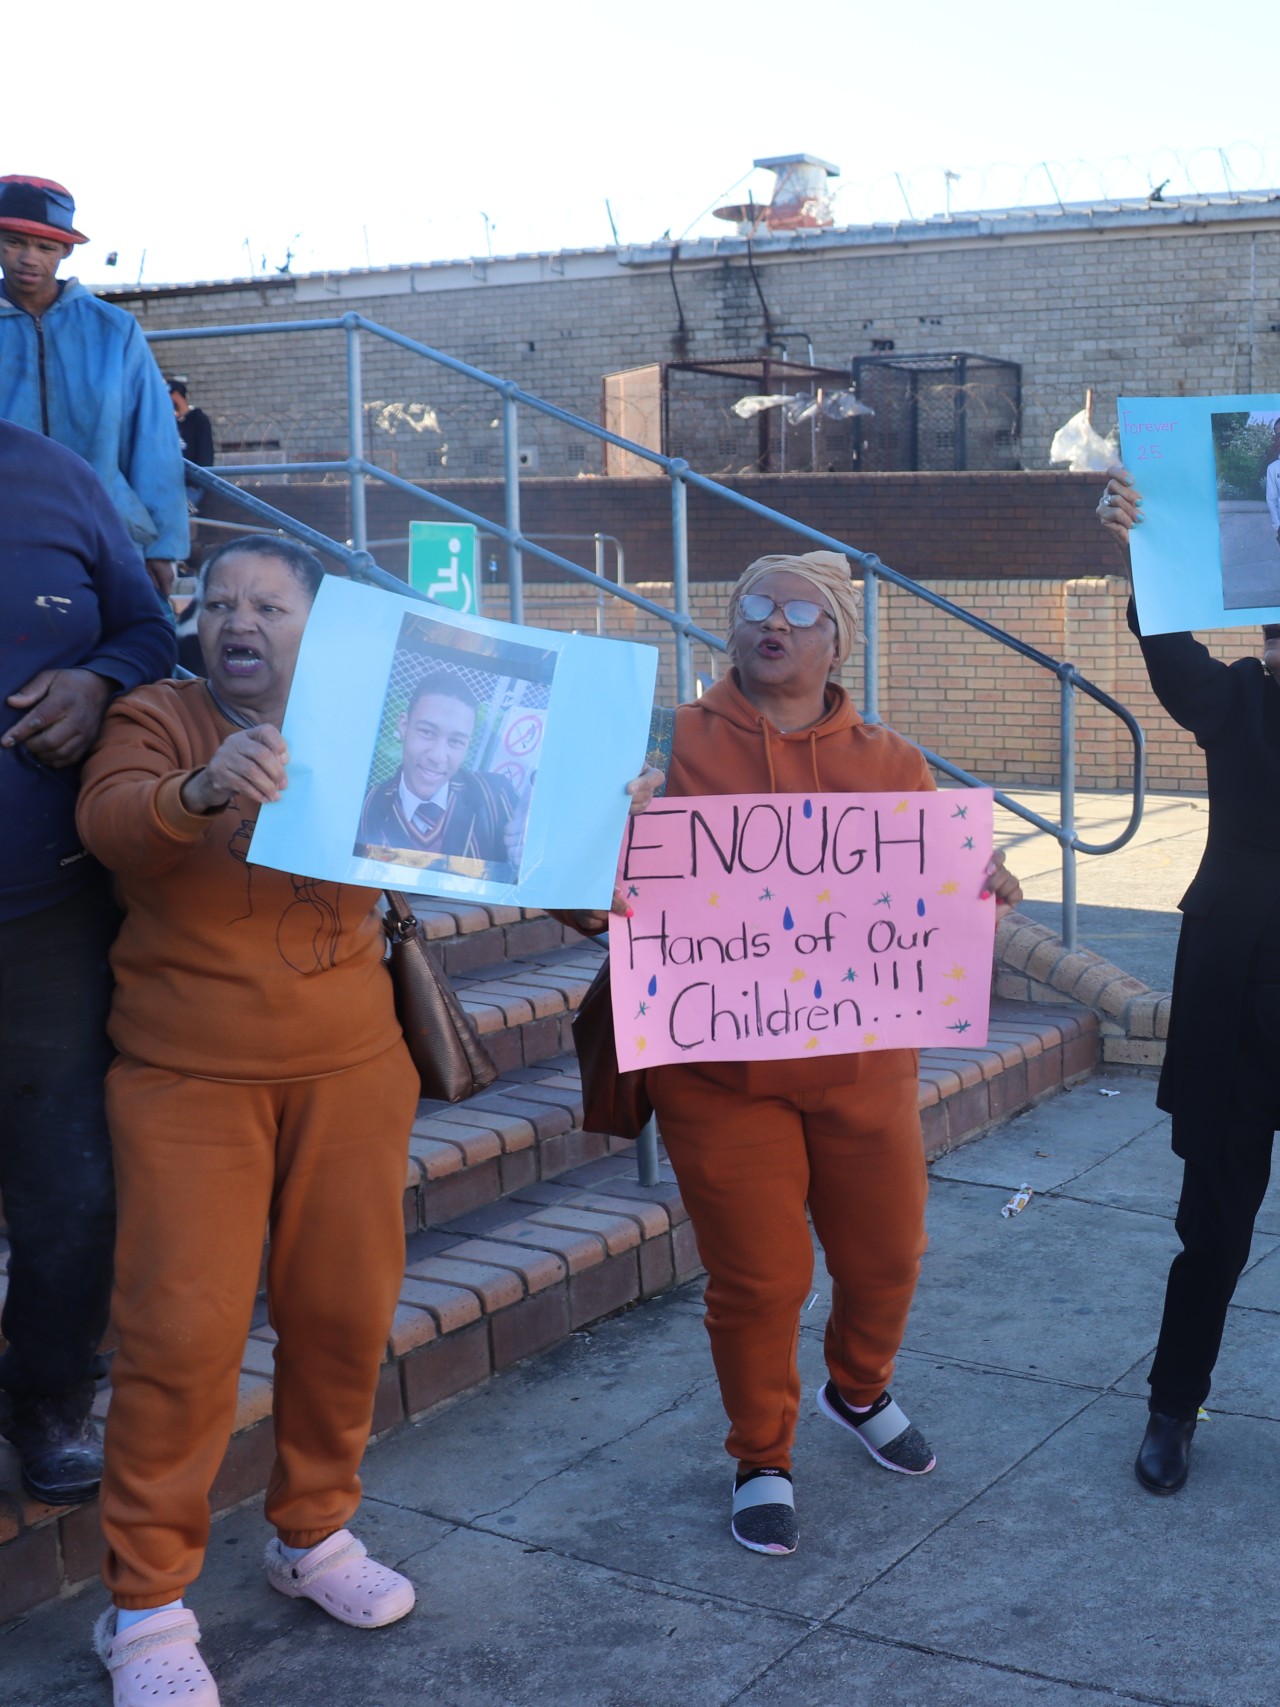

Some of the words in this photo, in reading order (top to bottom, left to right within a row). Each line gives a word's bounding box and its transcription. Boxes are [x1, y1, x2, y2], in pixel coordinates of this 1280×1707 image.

[1122, 410, 1179, 434] Forever
[1137, 444, 1164, 460] 25
[623, 804, 925, 880] ENOUGH
[626, 910, 771, 970] Hands
[794, 911, 847, 954] of
[866, 919, 940, 954] Our
